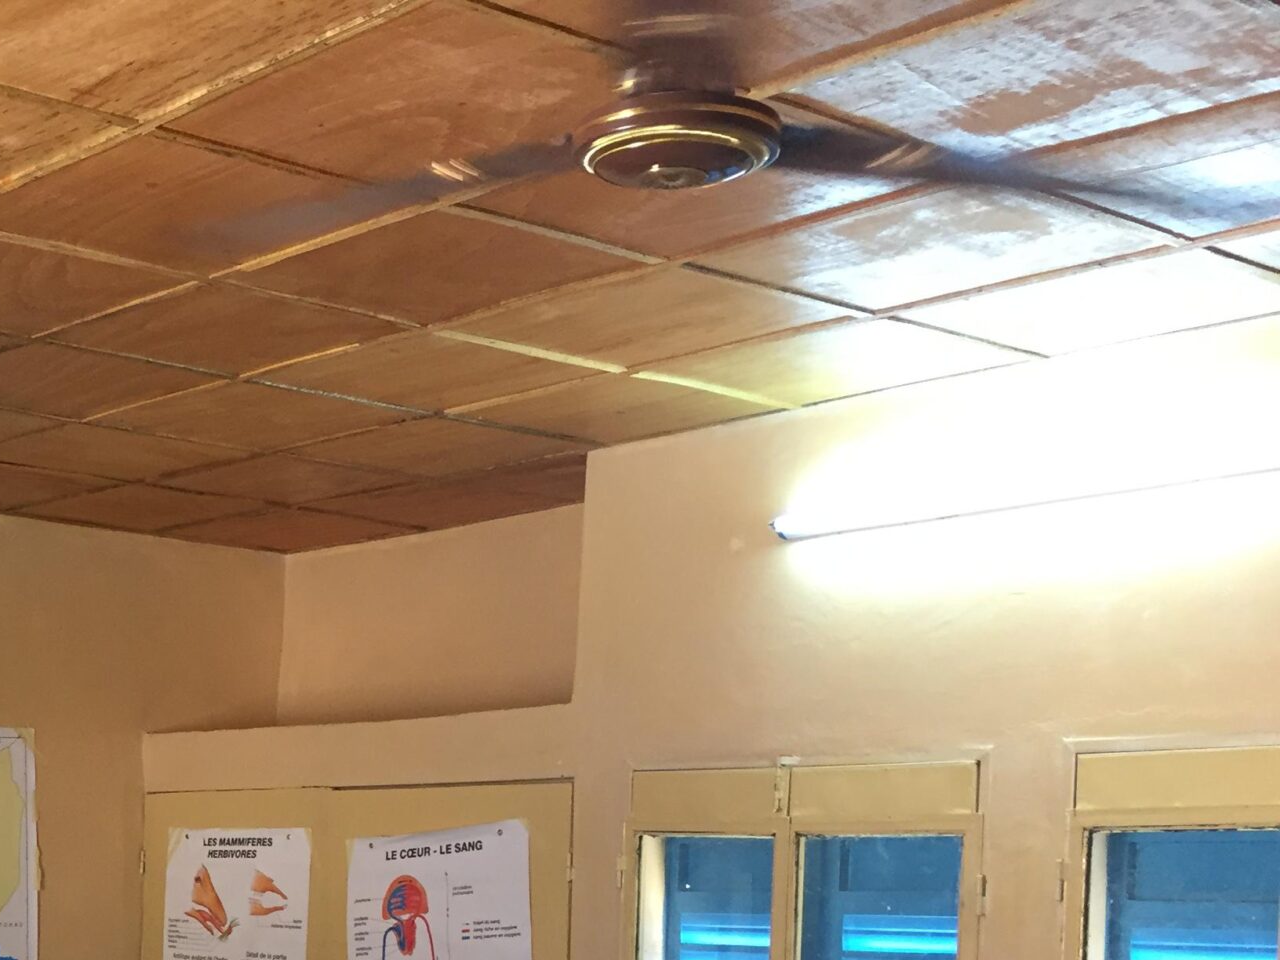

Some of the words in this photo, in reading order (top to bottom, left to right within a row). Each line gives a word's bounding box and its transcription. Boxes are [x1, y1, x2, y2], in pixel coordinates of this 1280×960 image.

[203, 838, 218, 847] LES
[219, 838, 273, 847] MAMMIFERES
[208, 850, 257, 859] HERBIVORES
[386, 850, 397, 860] LE
[440, 844, 452, 855] LE
[455, 841, 483, 853] SANG
